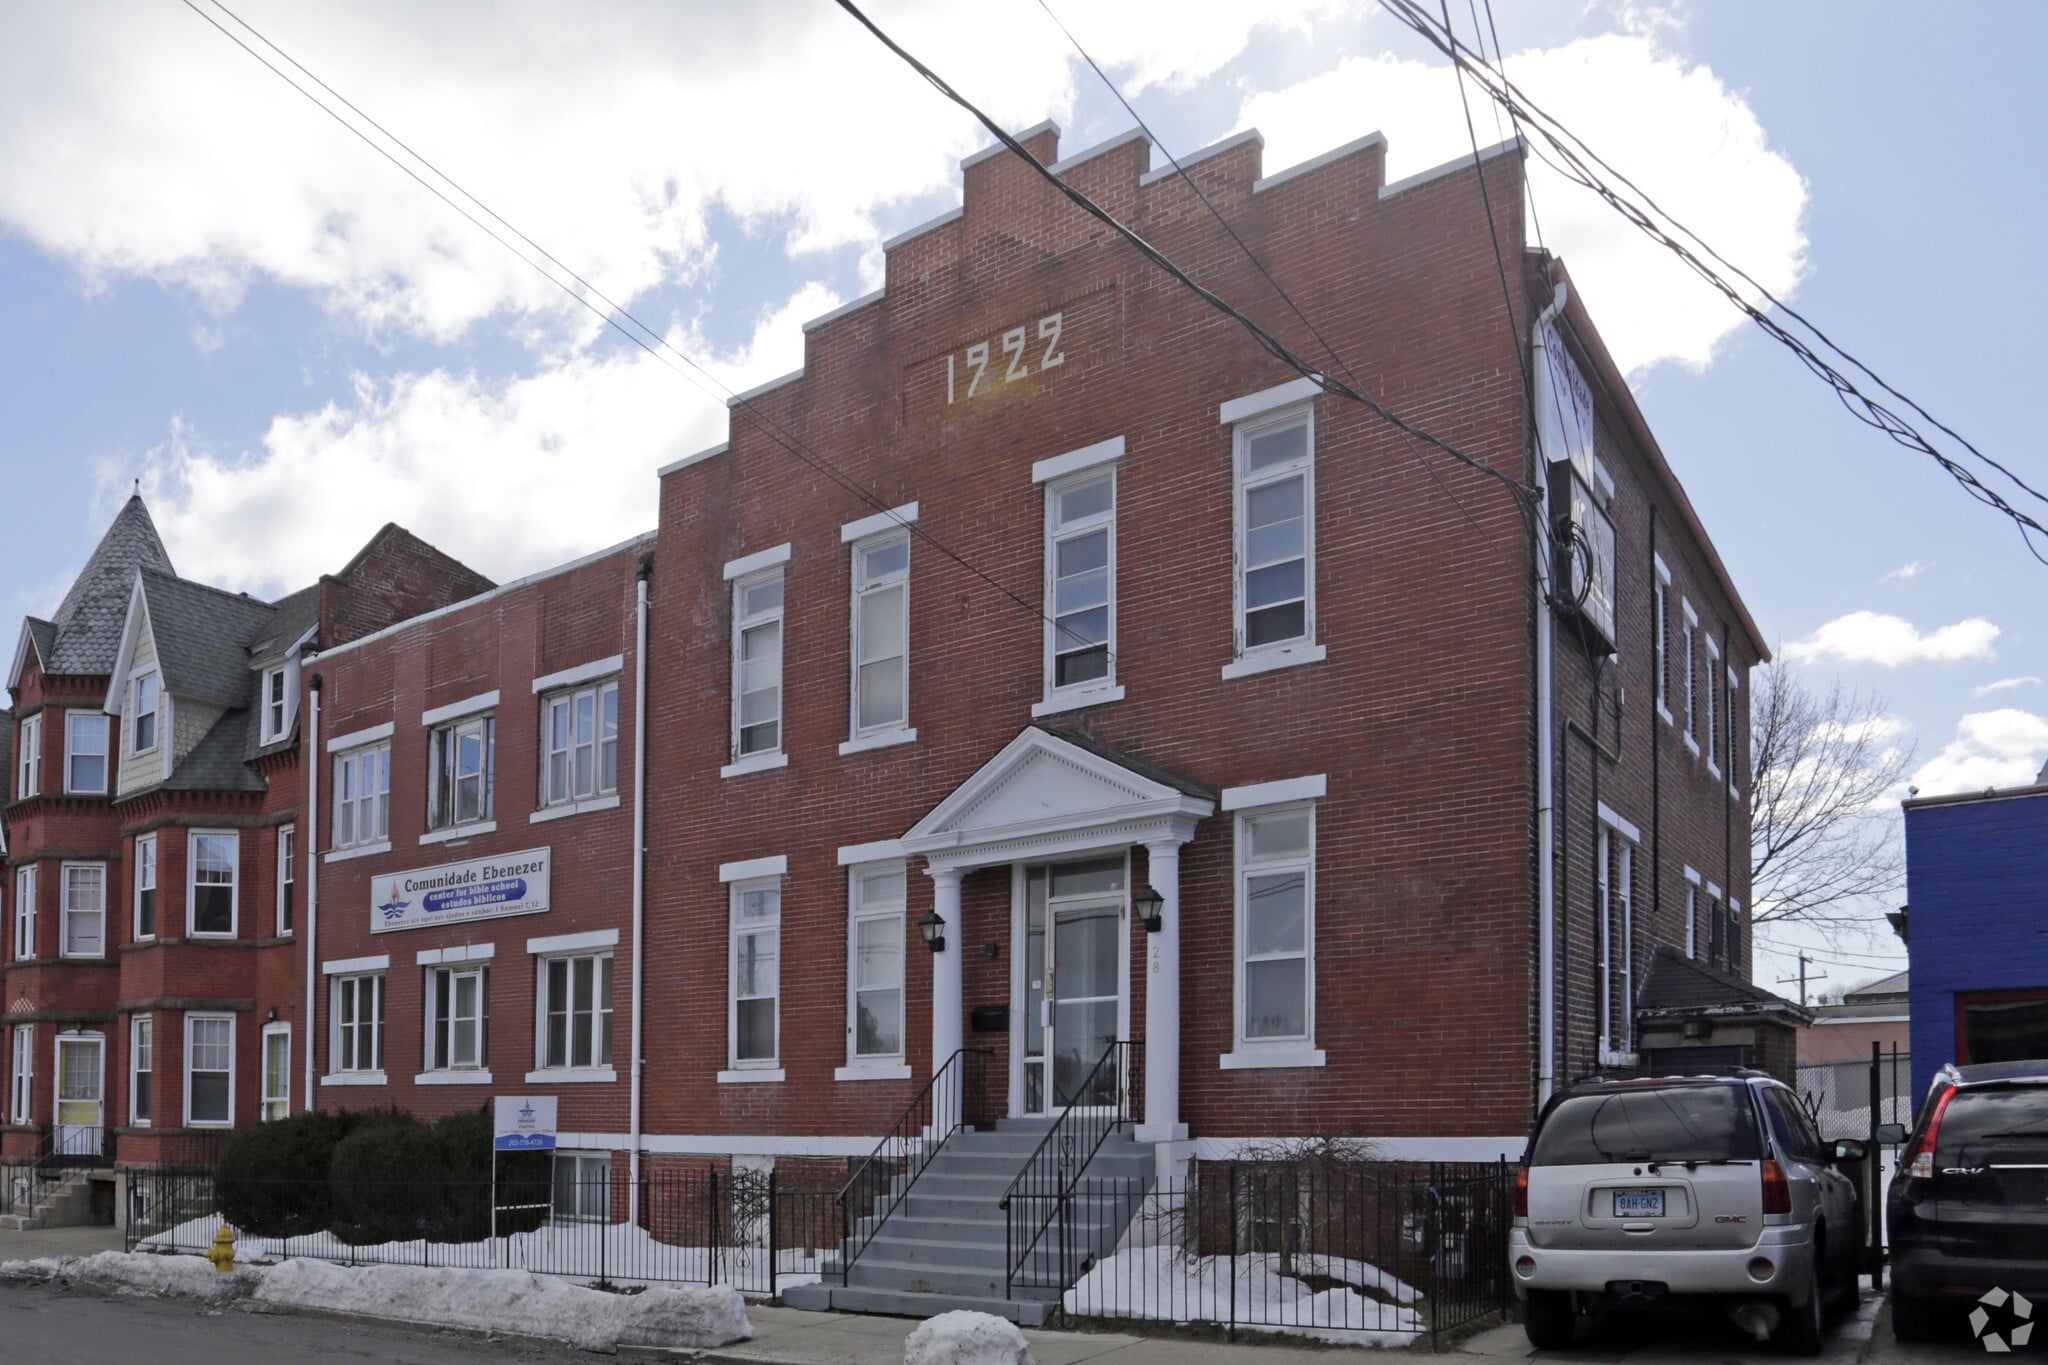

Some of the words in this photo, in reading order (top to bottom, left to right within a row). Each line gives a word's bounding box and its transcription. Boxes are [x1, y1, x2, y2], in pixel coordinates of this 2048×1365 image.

[948, 312, 1065, 405] 1922
[404, 869, 477, 892] Comunidade
[483, 861, 544, 880] Ebenezer
[429, 890, 454, 901] center
[456, 888, 467, 897] for
[469, 883, 489, 896] bible
[491, 879, 519, 892] school
[441, 897, 472, 909] estudos
[500, 903, 523, 911] Samuel
[531, 900, 539, 908] 12
[1715, 1215, 1747, 1224] GMC
